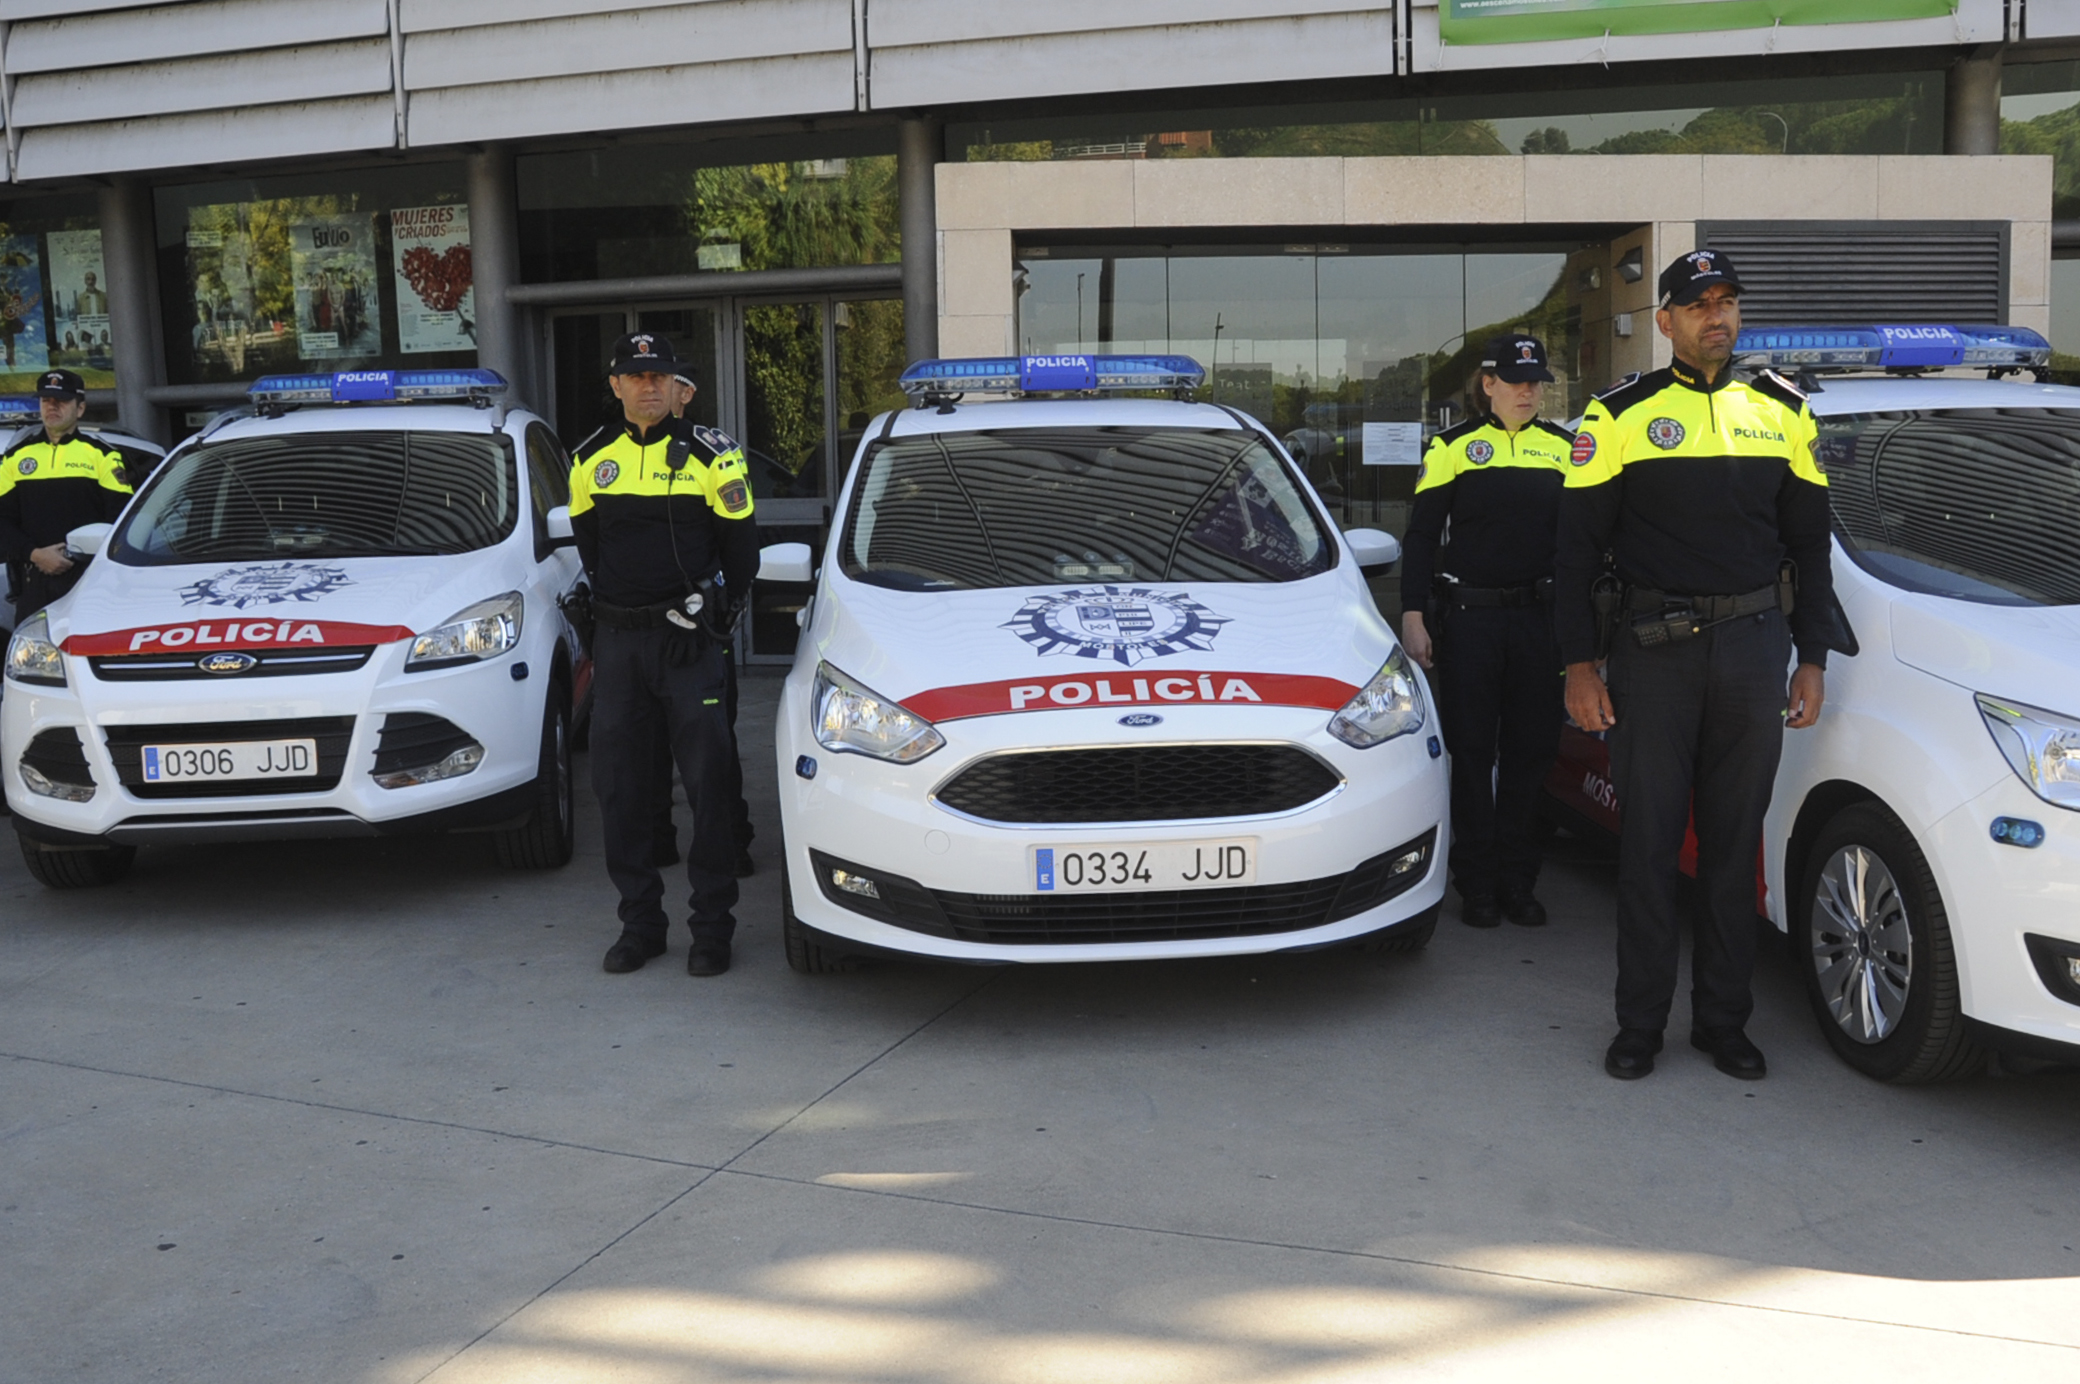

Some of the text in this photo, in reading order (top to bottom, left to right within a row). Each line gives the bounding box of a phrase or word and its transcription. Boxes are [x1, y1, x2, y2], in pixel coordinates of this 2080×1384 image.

[392, 206, 454, 226] MUJERES
[398, 224, 447, 239] CRIADOS
[1882, 327, 1954, 339] POLICIA
[1026, 356, 1088, 368] POLICIA
[337, 372, 389, 383] POLICIA
[1733, 428, 1786, 442] POLICIA
[65, 462, 95, 471] POLICIA
[652, 472, 696, 482] POCIA
[129, 620, 325, 651] POLICÍA
[209, 655, 243, 670] Ford
[1009, 674, 1263, 710] POLICÍA
[1126, 714, 1154, 726] Ford
[165, 748, 234, 776] 0306
[257, 745, 309, 772] JJD
[1040, 845, 1246, 886] E 0334 JJD
